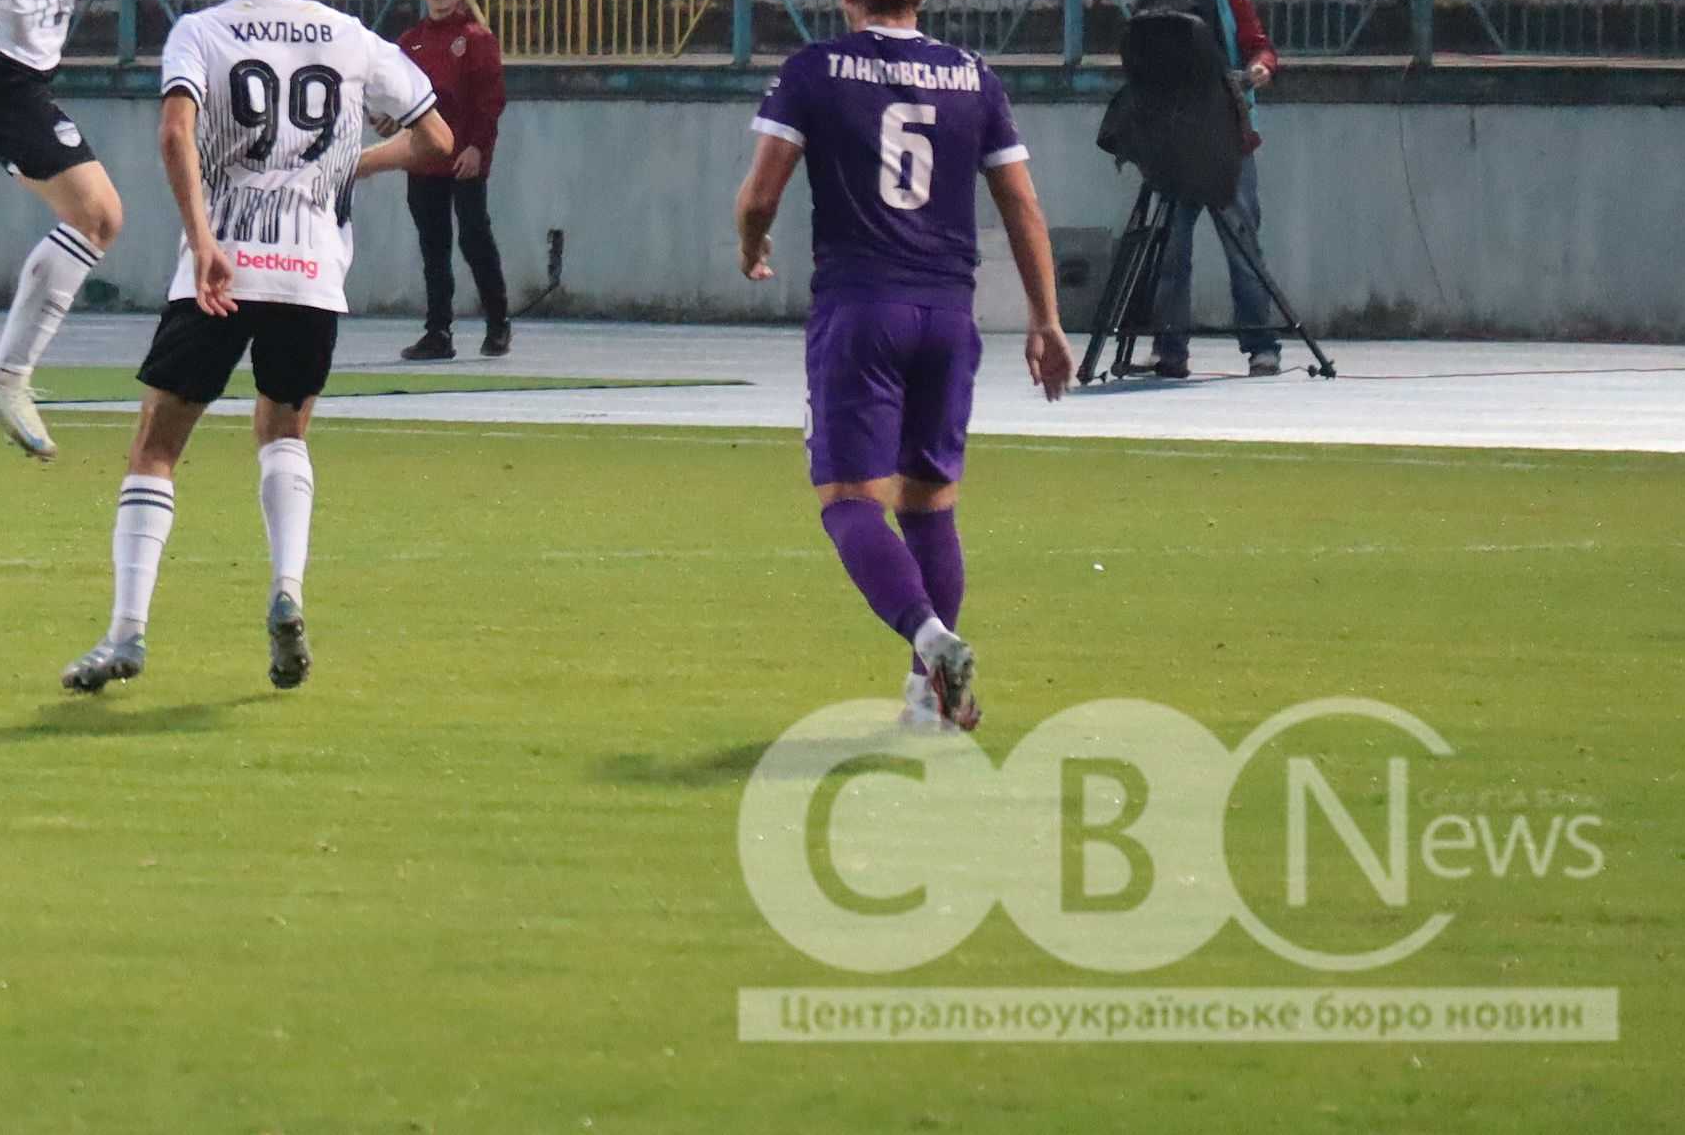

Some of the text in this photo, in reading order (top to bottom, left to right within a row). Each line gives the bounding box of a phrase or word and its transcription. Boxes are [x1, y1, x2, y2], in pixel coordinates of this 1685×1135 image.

[230, 22, 333, 43] ХАХЛЬОВ
[229, 59, 342, 161] 99
[879, 102, 936, 210] 6
[236, 250, 318, 279] betking
